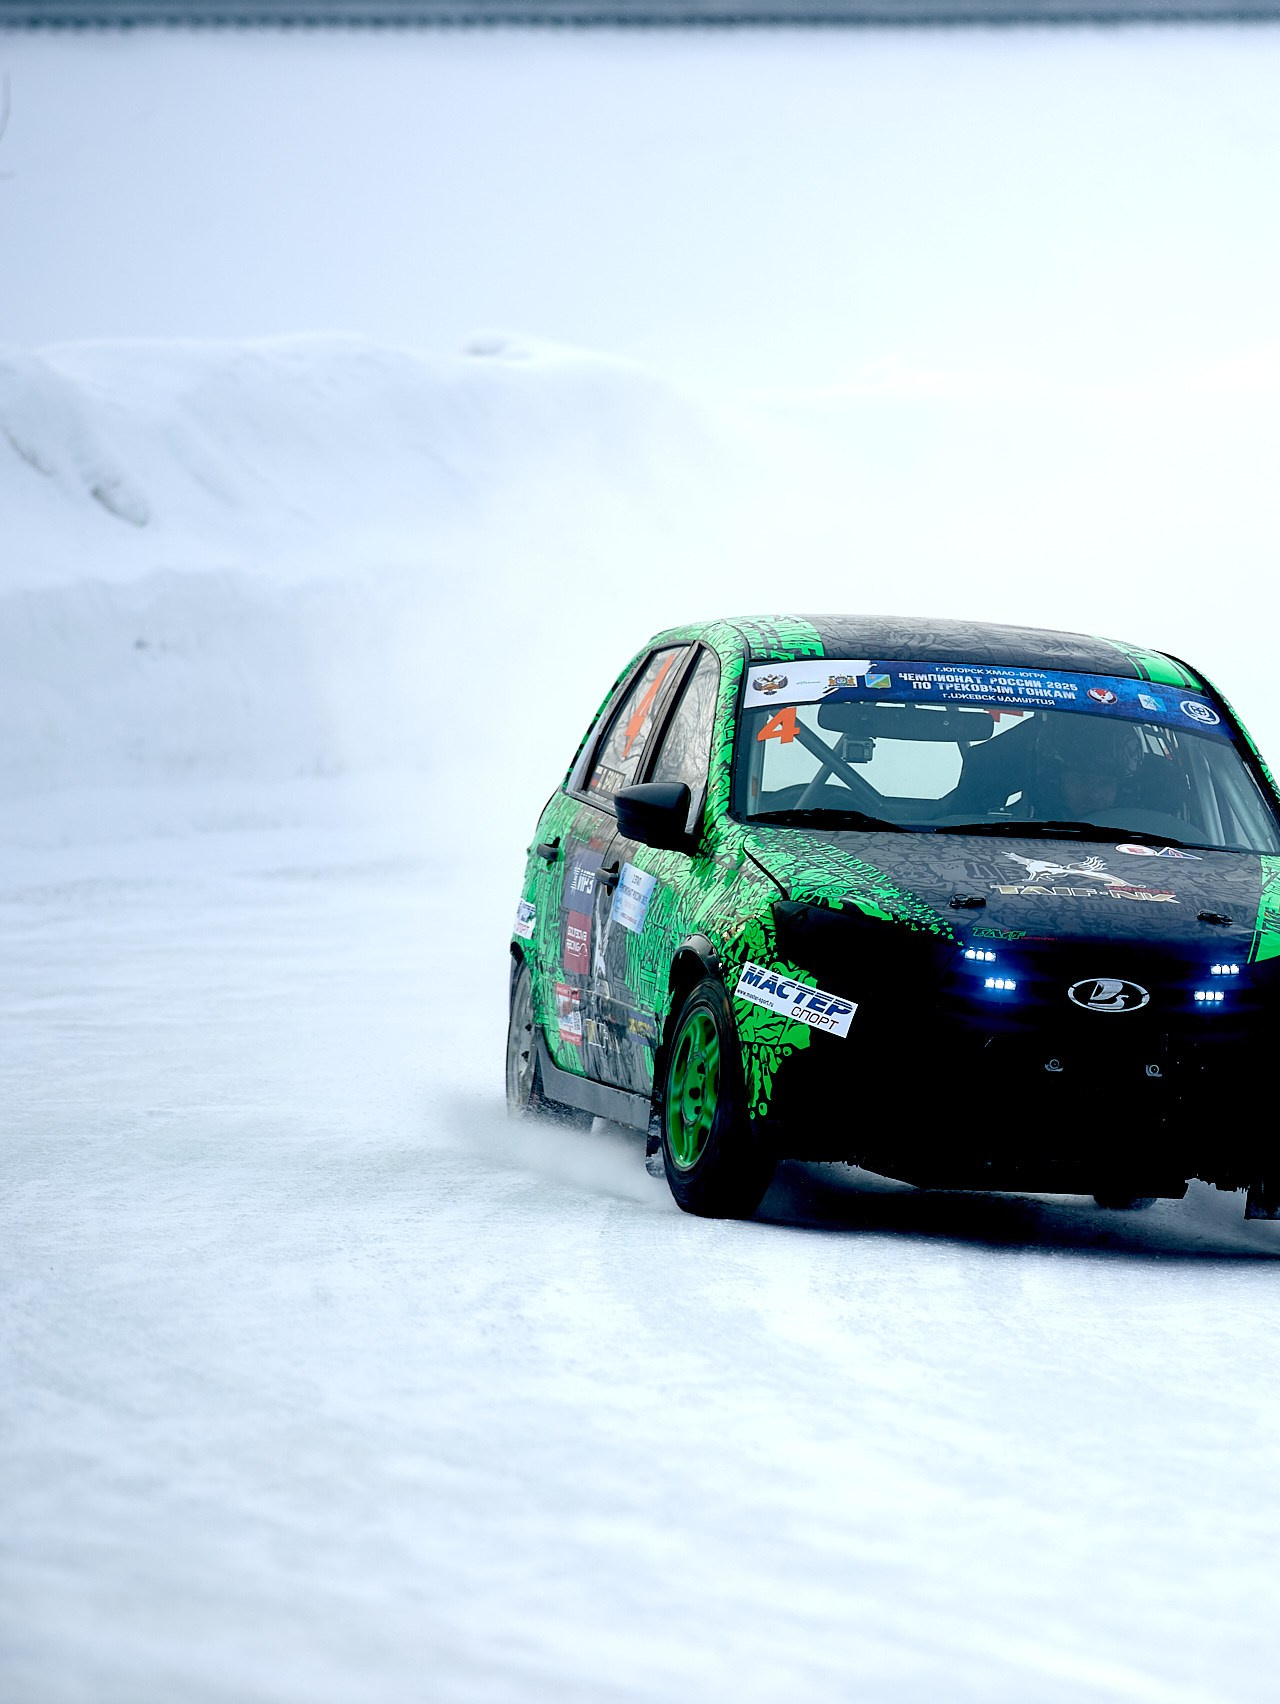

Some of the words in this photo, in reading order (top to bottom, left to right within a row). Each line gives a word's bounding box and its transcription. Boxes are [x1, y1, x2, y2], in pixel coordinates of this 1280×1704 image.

[899, 672, 982, 685] ЧЕМПИОНАТ
[990, 677, 1042, 688] РОССИИ
[1046, 681, 1078, 691] 2025
[912, 681, 932, 690] ПО
[938, 682, 1014, 695] ТРЕКОВЫМ
[1019, 687, 1077, 700] ГОНКАМ
[757, 707, 800, 744] 4
[741, 965, 853, 1017] МАСТЕР
[791, 1006, 839, 1030] СПОРТ
